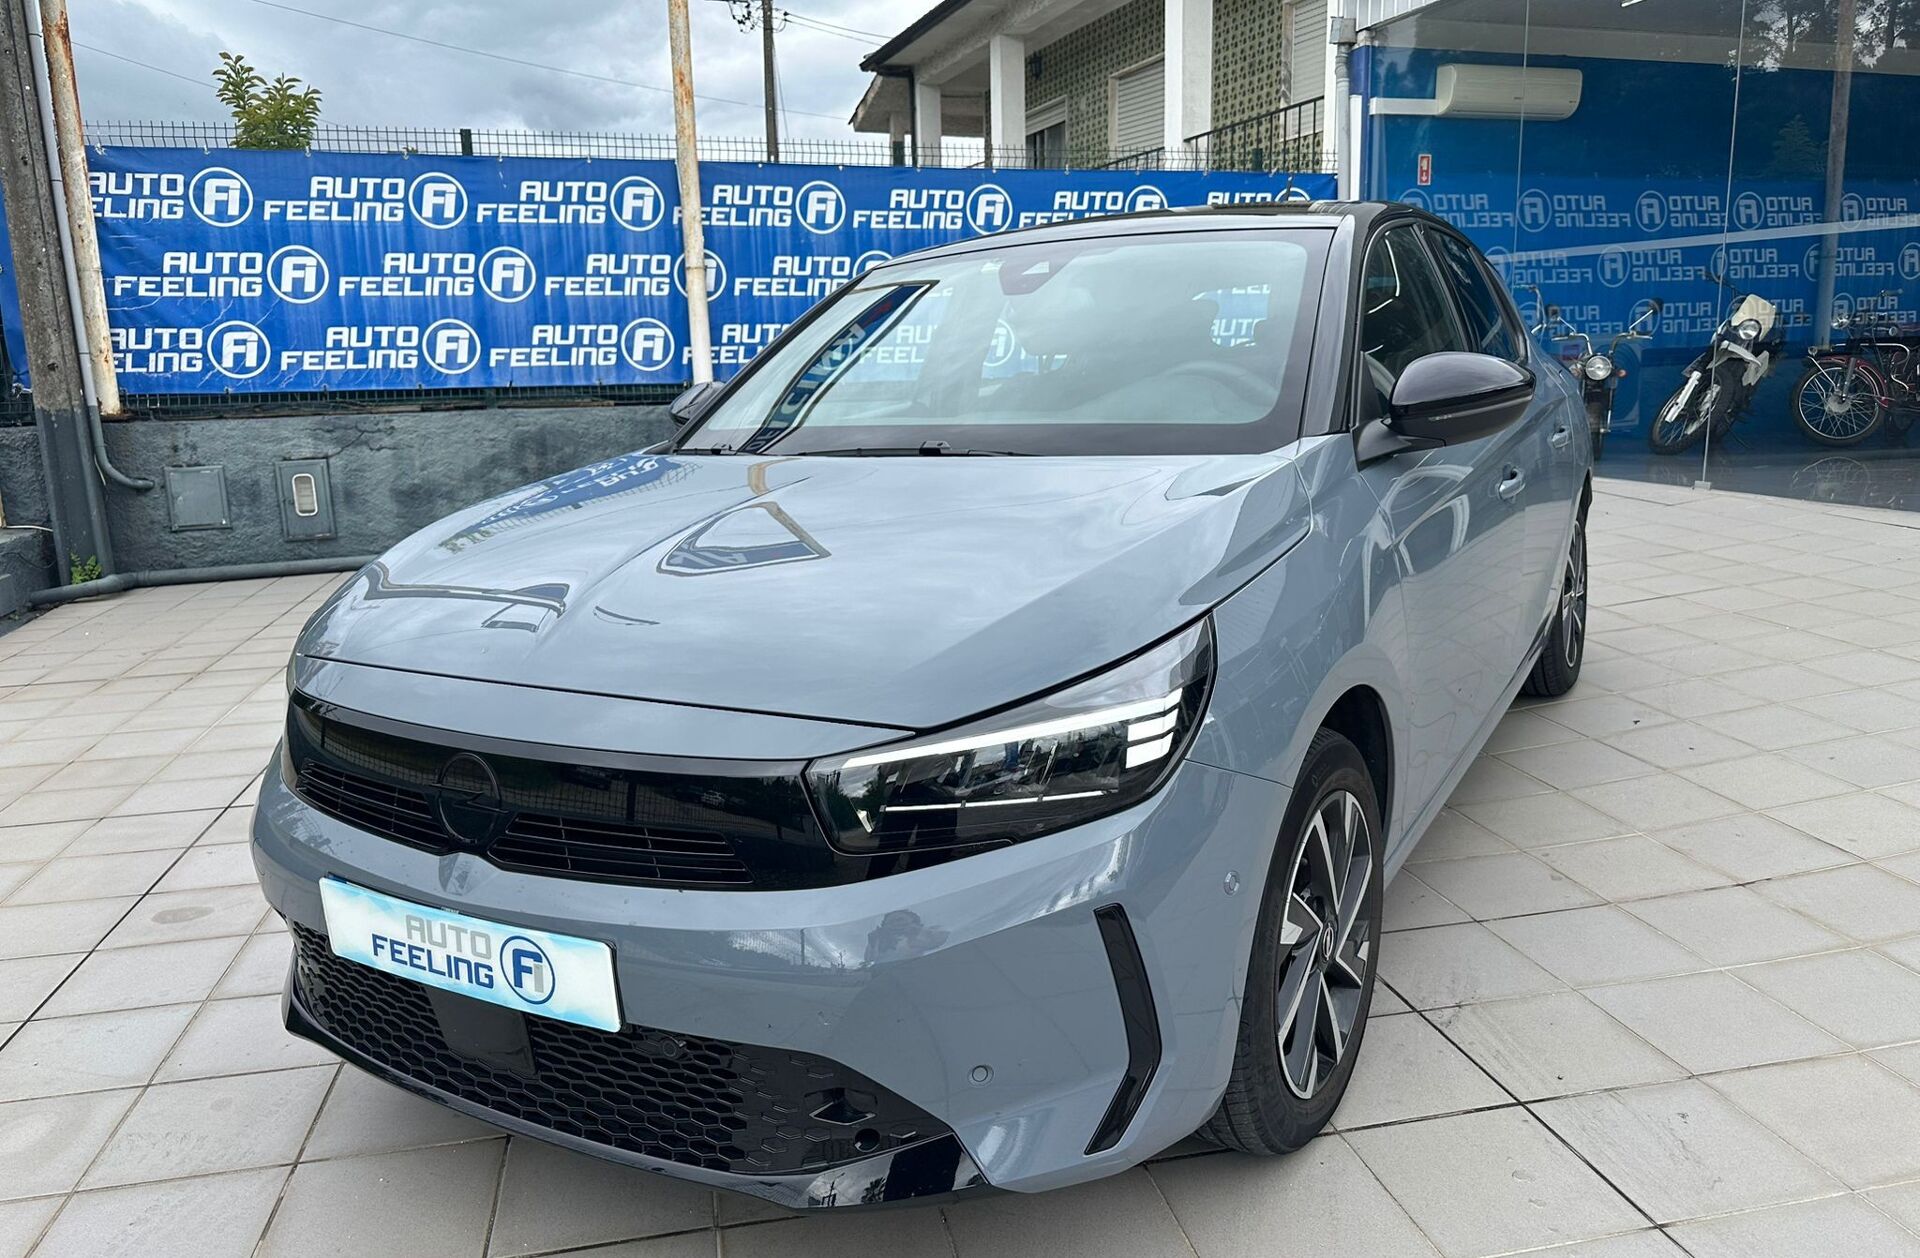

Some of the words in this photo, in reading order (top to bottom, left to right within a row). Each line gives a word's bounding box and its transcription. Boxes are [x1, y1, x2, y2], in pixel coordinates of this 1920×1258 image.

[88, 172, 184, 196] AUTO
[310, 176, 405, 200] AUTO
[520, 181, 607, 202] AUTO
[713, 185, 793, 206] AUTO
[890, 189, 965, 209] AUTO
[1053, 190, 1124, 210] AUTO
[263, 201, 404, 222] FEELING
[476, 204, 606, 224] FEELING
[852, 210, 963, 229] FEELING
[163, 252, 263, 275] AUTO
[383, 252, 476, 275] AUTO
[586, 253, 671, 275] AUTO
[772, 256, 850, 276] AUTO
[114, 275, 263, 297] FEELING
[338, 276, 475, 297] FEELING
[544, 276, 670, 297] FEELING
[111, 328, 203, 350] AUTO
[326, 326, 419, 348] AUTO
[532, 324, 618, 346] AUTO
[722, 323, 792, 344] AUT
[280, 349, 419, 371] FEELING
[490, 347, 617, 367] FEELING
[405, 914, 492, 960] AUTO
[371, 933, 495, 990] FEELING
